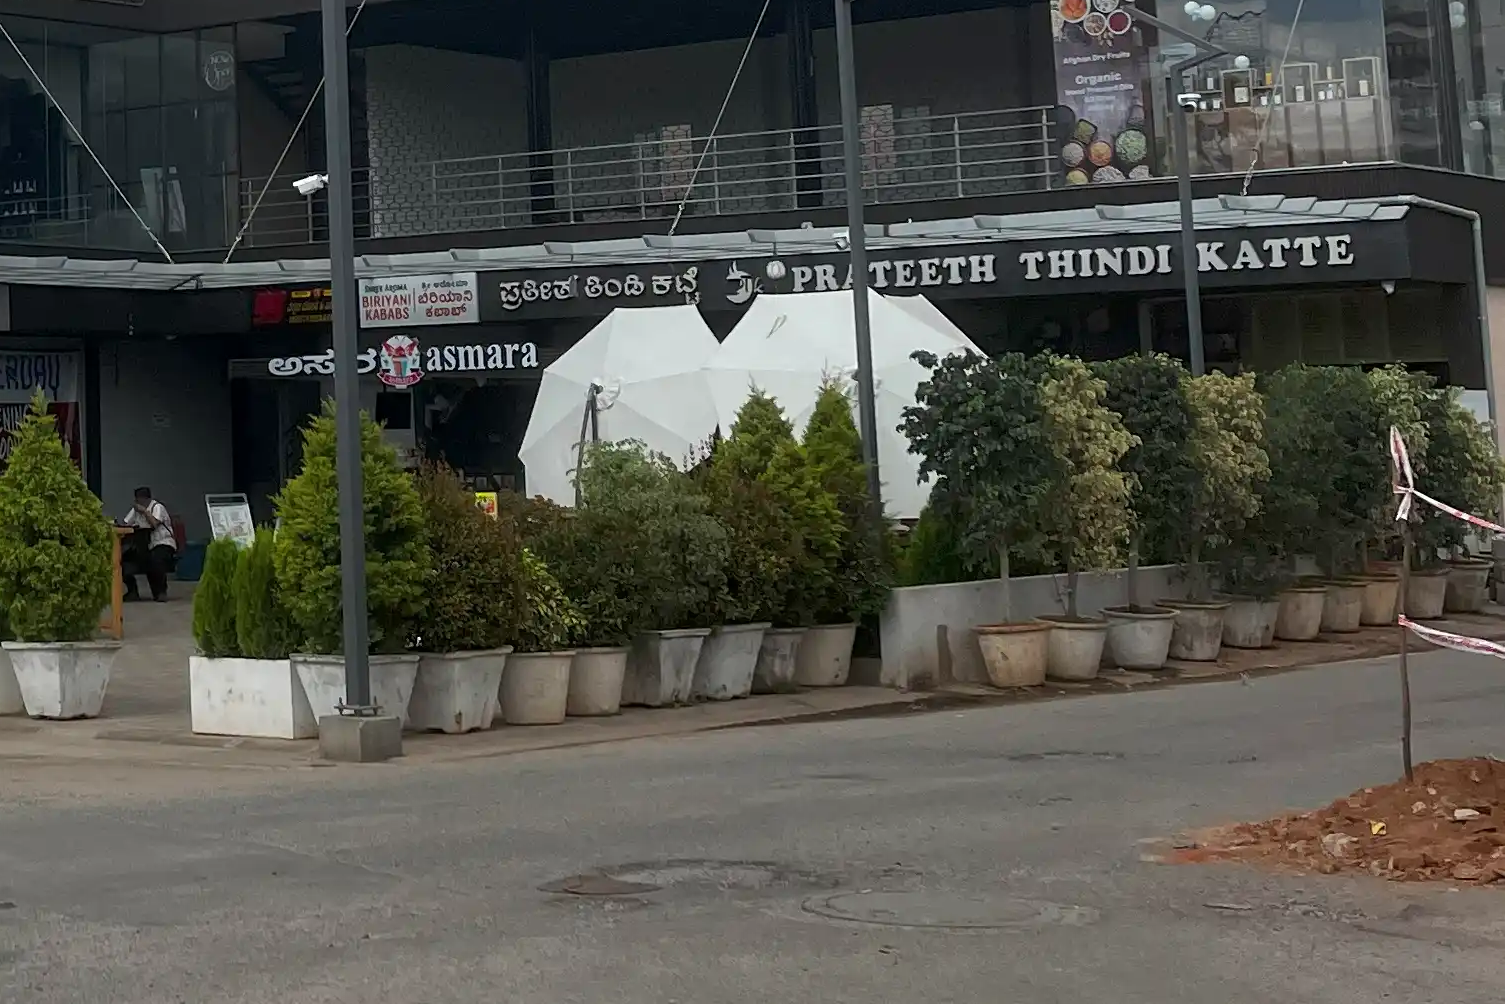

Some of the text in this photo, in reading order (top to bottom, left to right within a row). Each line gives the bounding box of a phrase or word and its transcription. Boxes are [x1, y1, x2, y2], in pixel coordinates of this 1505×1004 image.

[1092, 54, 1106, 62] Dry
[1075, 72, 1122, 85] Organic
[1019, 244, 1172, 280] THINDI
[1197, 234, 1354, 272] KATTE
[584, 275, 644, 298] ತಿಂಡಿ
[362, 294, 411, 308] BIRIYANI
[365, 307, 410, 320] KABABS
[426, 342, 539, 372] asmara
